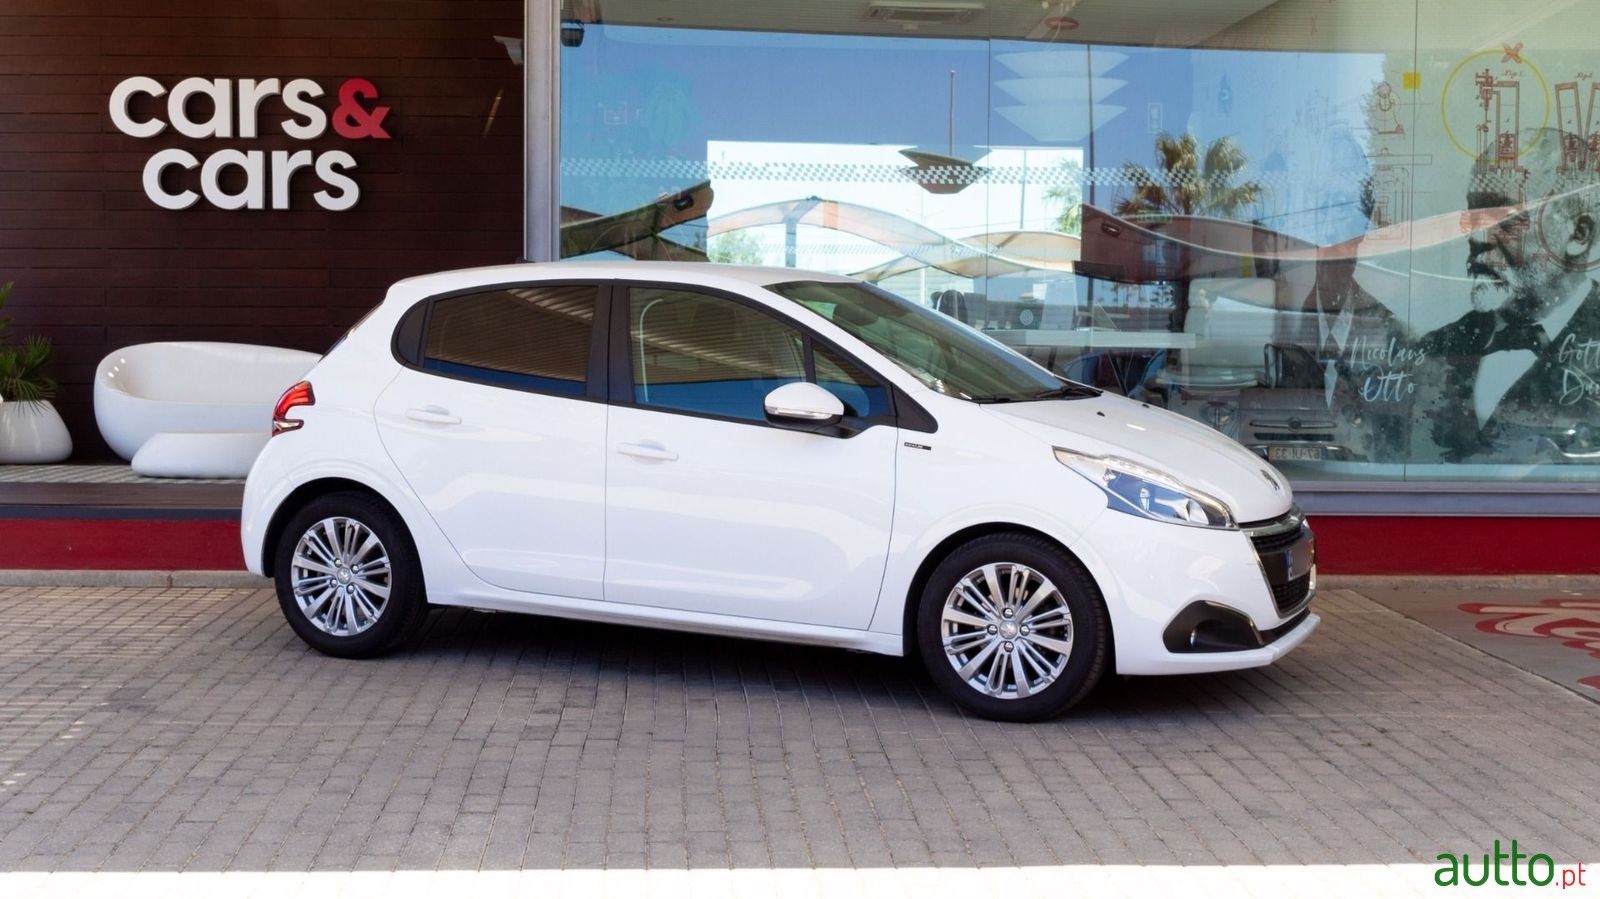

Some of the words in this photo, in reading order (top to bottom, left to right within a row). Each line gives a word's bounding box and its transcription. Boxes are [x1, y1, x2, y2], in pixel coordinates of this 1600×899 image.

[142, 148, 361, 212] cars
[1350, 335, 1425, 370] Nicolaus
[1358, 366, 1418, 402] Otto
